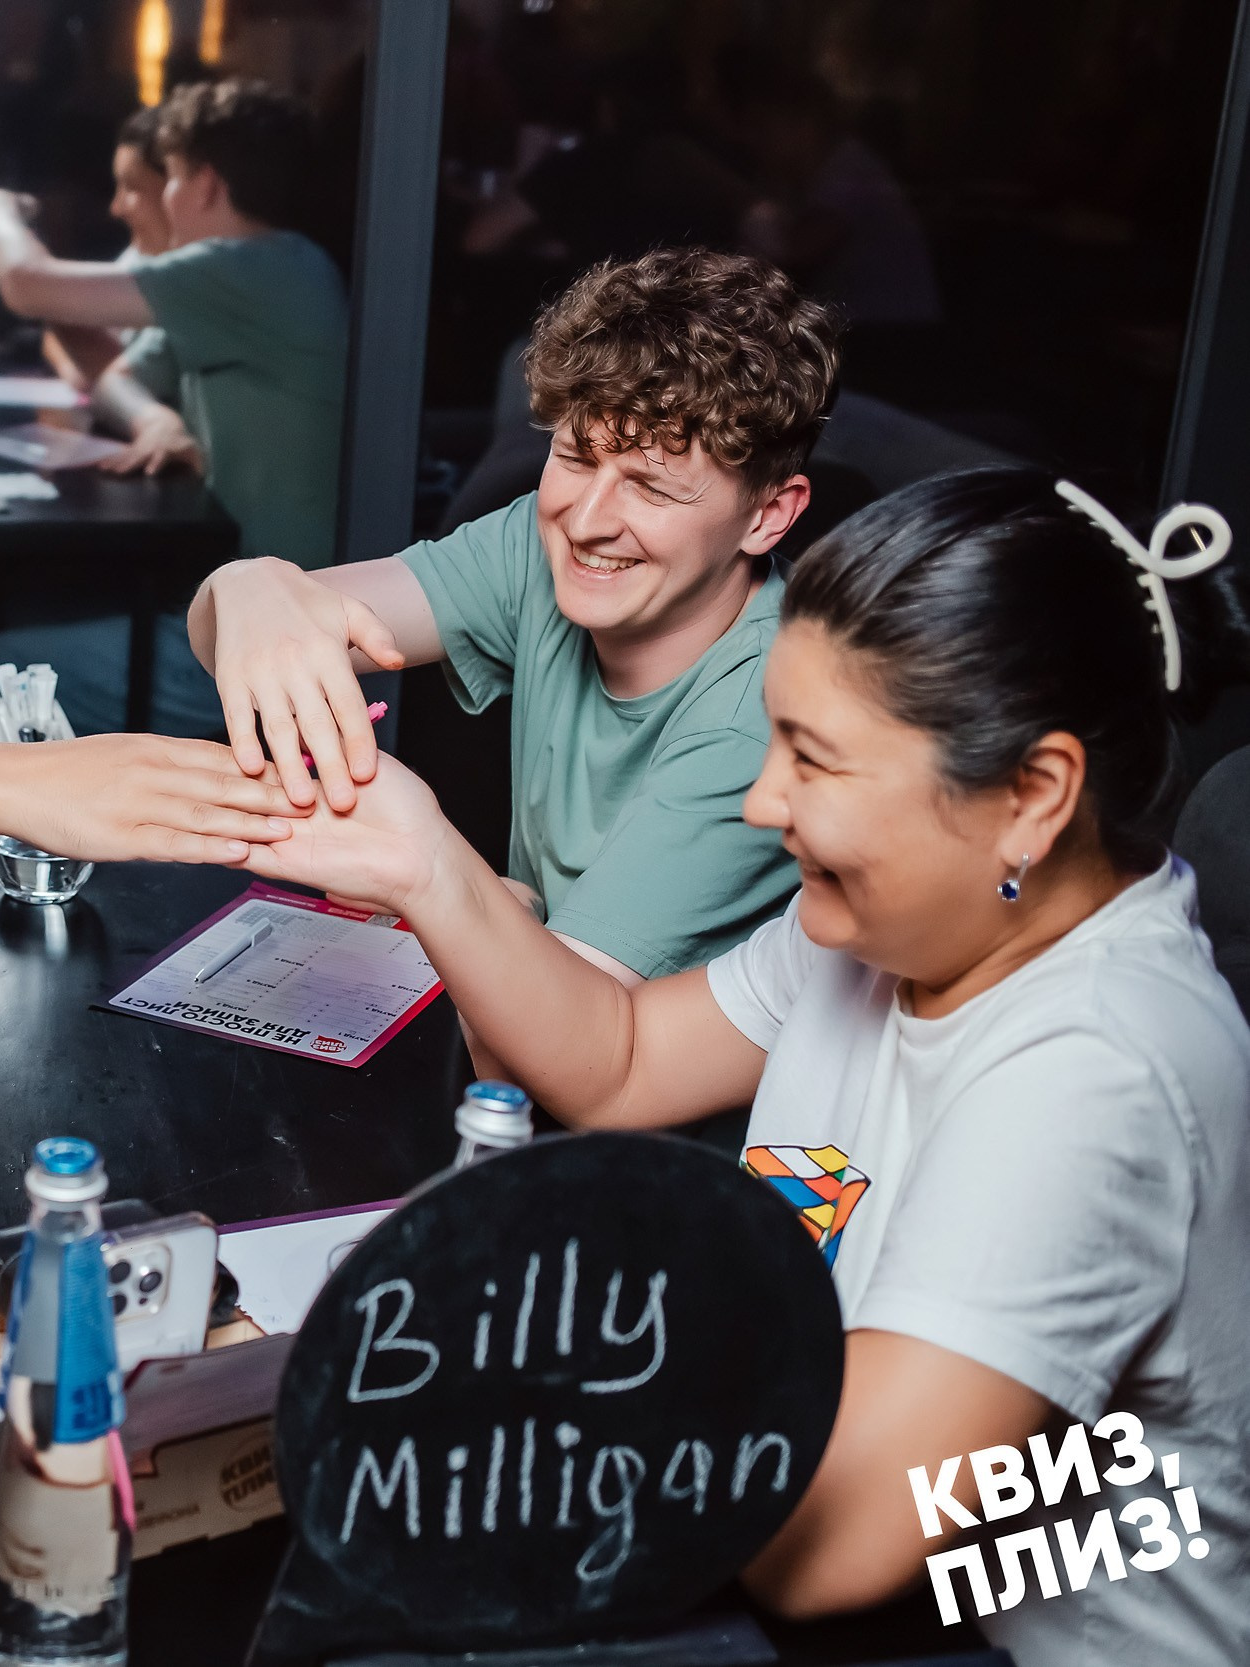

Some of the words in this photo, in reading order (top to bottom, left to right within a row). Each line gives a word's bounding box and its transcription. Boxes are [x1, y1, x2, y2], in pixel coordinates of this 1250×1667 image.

[119, 997, 180, 1015] ЛИСТ
[181, 1011, 270, 1038] ПРОСТО
[261, 1022, 311, 1038] ДЛЯ
[272, 1033, 302, 1045] НЕ
[347, 1237, 667, 1402] Billy
[221, 1445, 272, 1484] КВИ
[340, 1416, 791, 1582] Milligan
